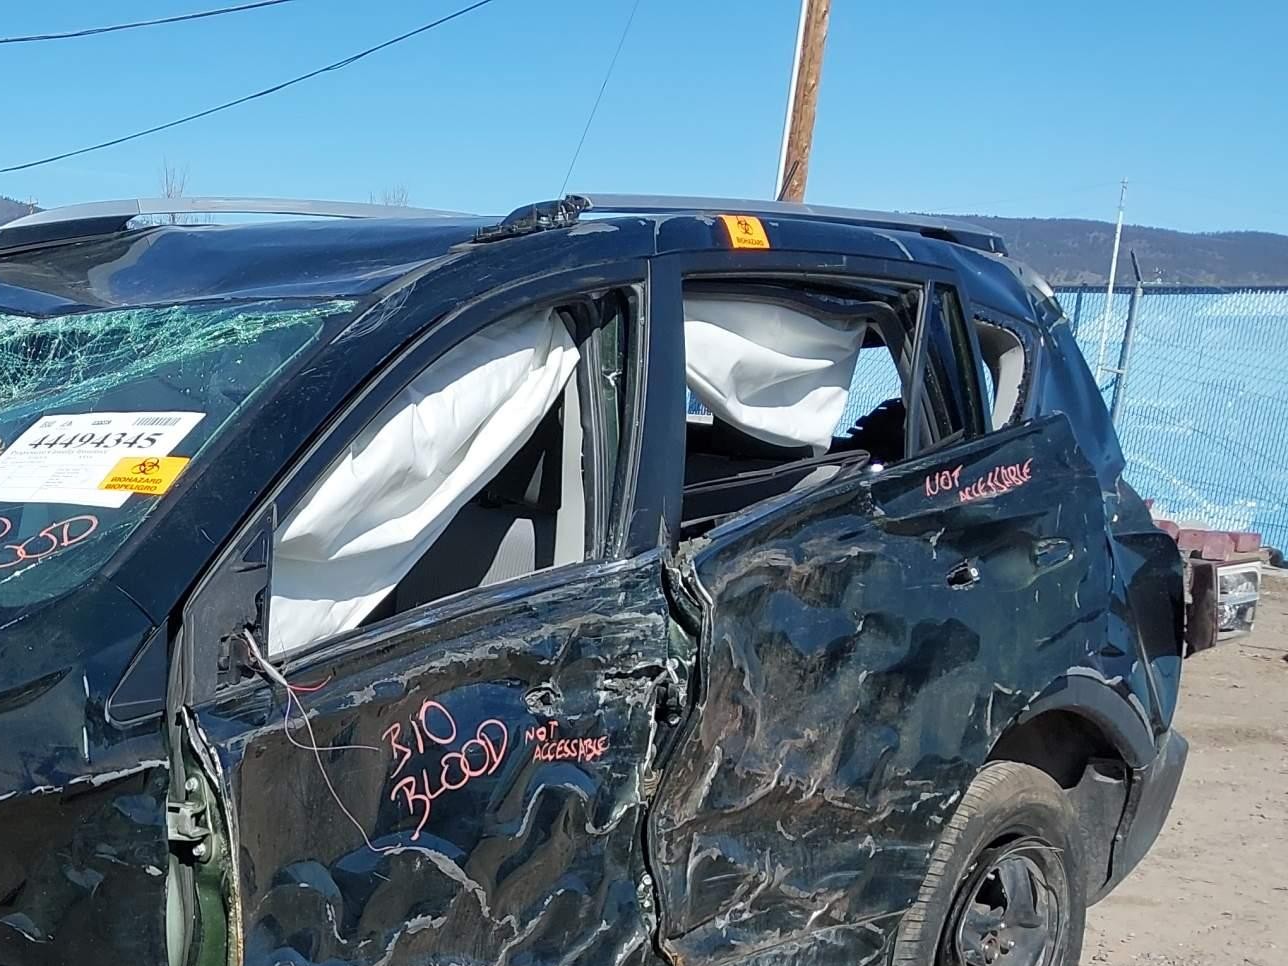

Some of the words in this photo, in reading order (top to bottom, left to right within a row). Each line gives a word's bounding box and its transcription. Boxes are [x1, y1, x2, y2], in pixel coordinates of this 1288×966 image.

[28, 432, 164, 449] 44494345
[104, 483, 158, 491] BIOPELIGRO
[110, 477, 163, 485] BIOHAZARD
[925, 464, 963, 497] NOT
[382, 699, 456, 779] BIO
[525, 721, 558, 746] NOT
[391, 719, 508, 840] BLOOD
